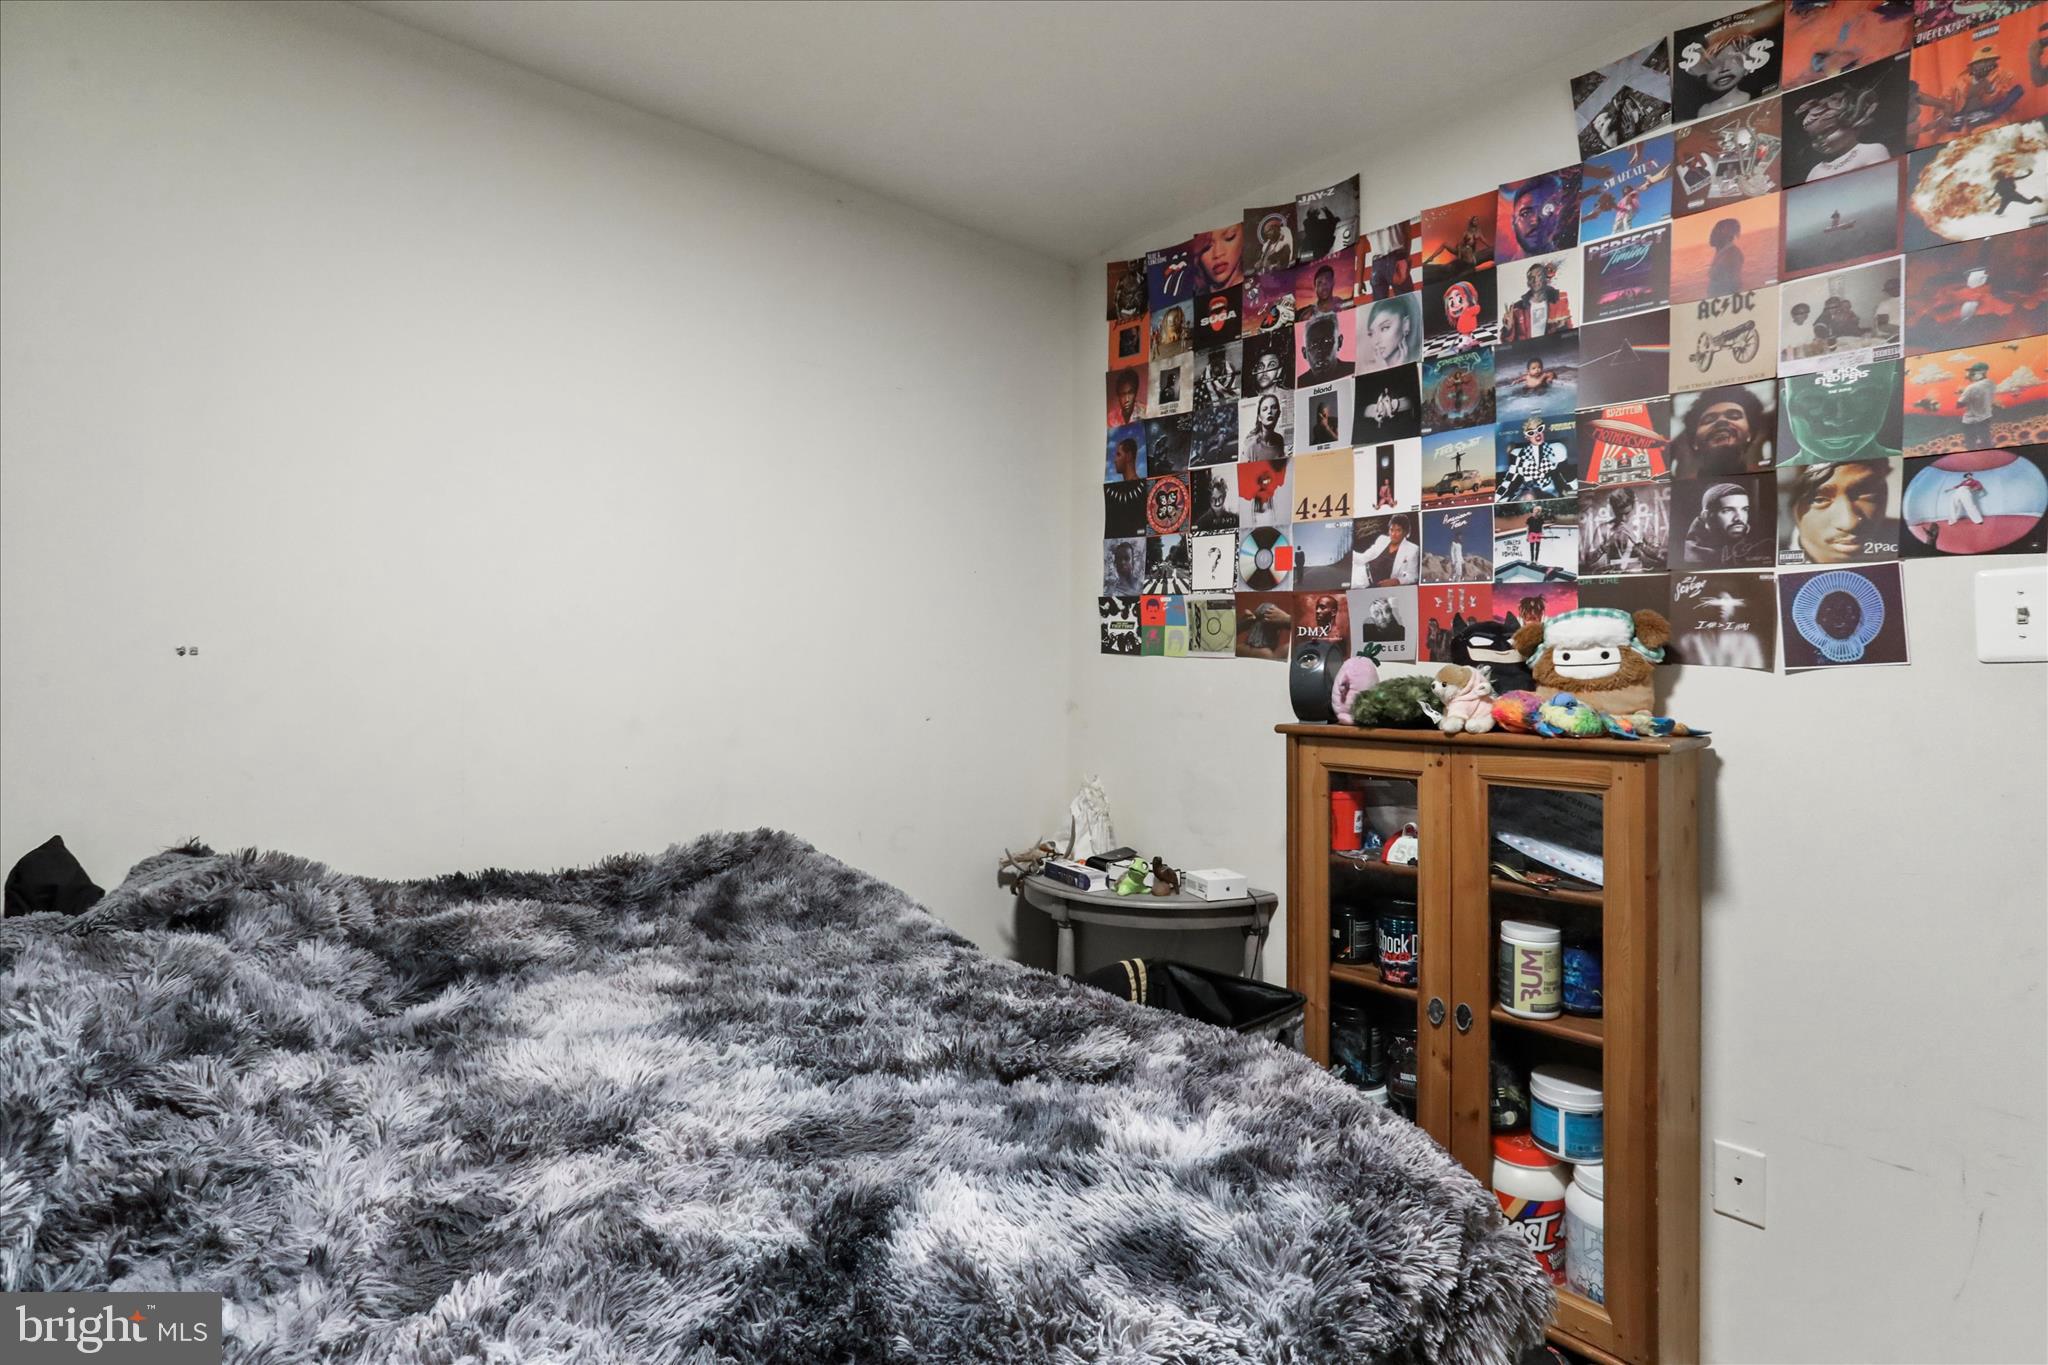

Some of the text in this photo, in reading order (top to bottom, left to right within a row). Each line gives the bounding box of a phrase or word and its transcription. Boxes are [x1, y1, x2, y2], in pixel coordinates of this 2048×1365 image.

[1297, 187, 1335, 204] JAY-Z
[1588, 227, 1666, 260] PERFECT
[1200, 310, 1237, 327] SUGA
[1313, 384, 1333, 395] blond
[1295, 492, 1350, 520] 4:44
[1863, 541, 1899, 554] 2Pac
[1297, 626, 1330, 637] DMX
